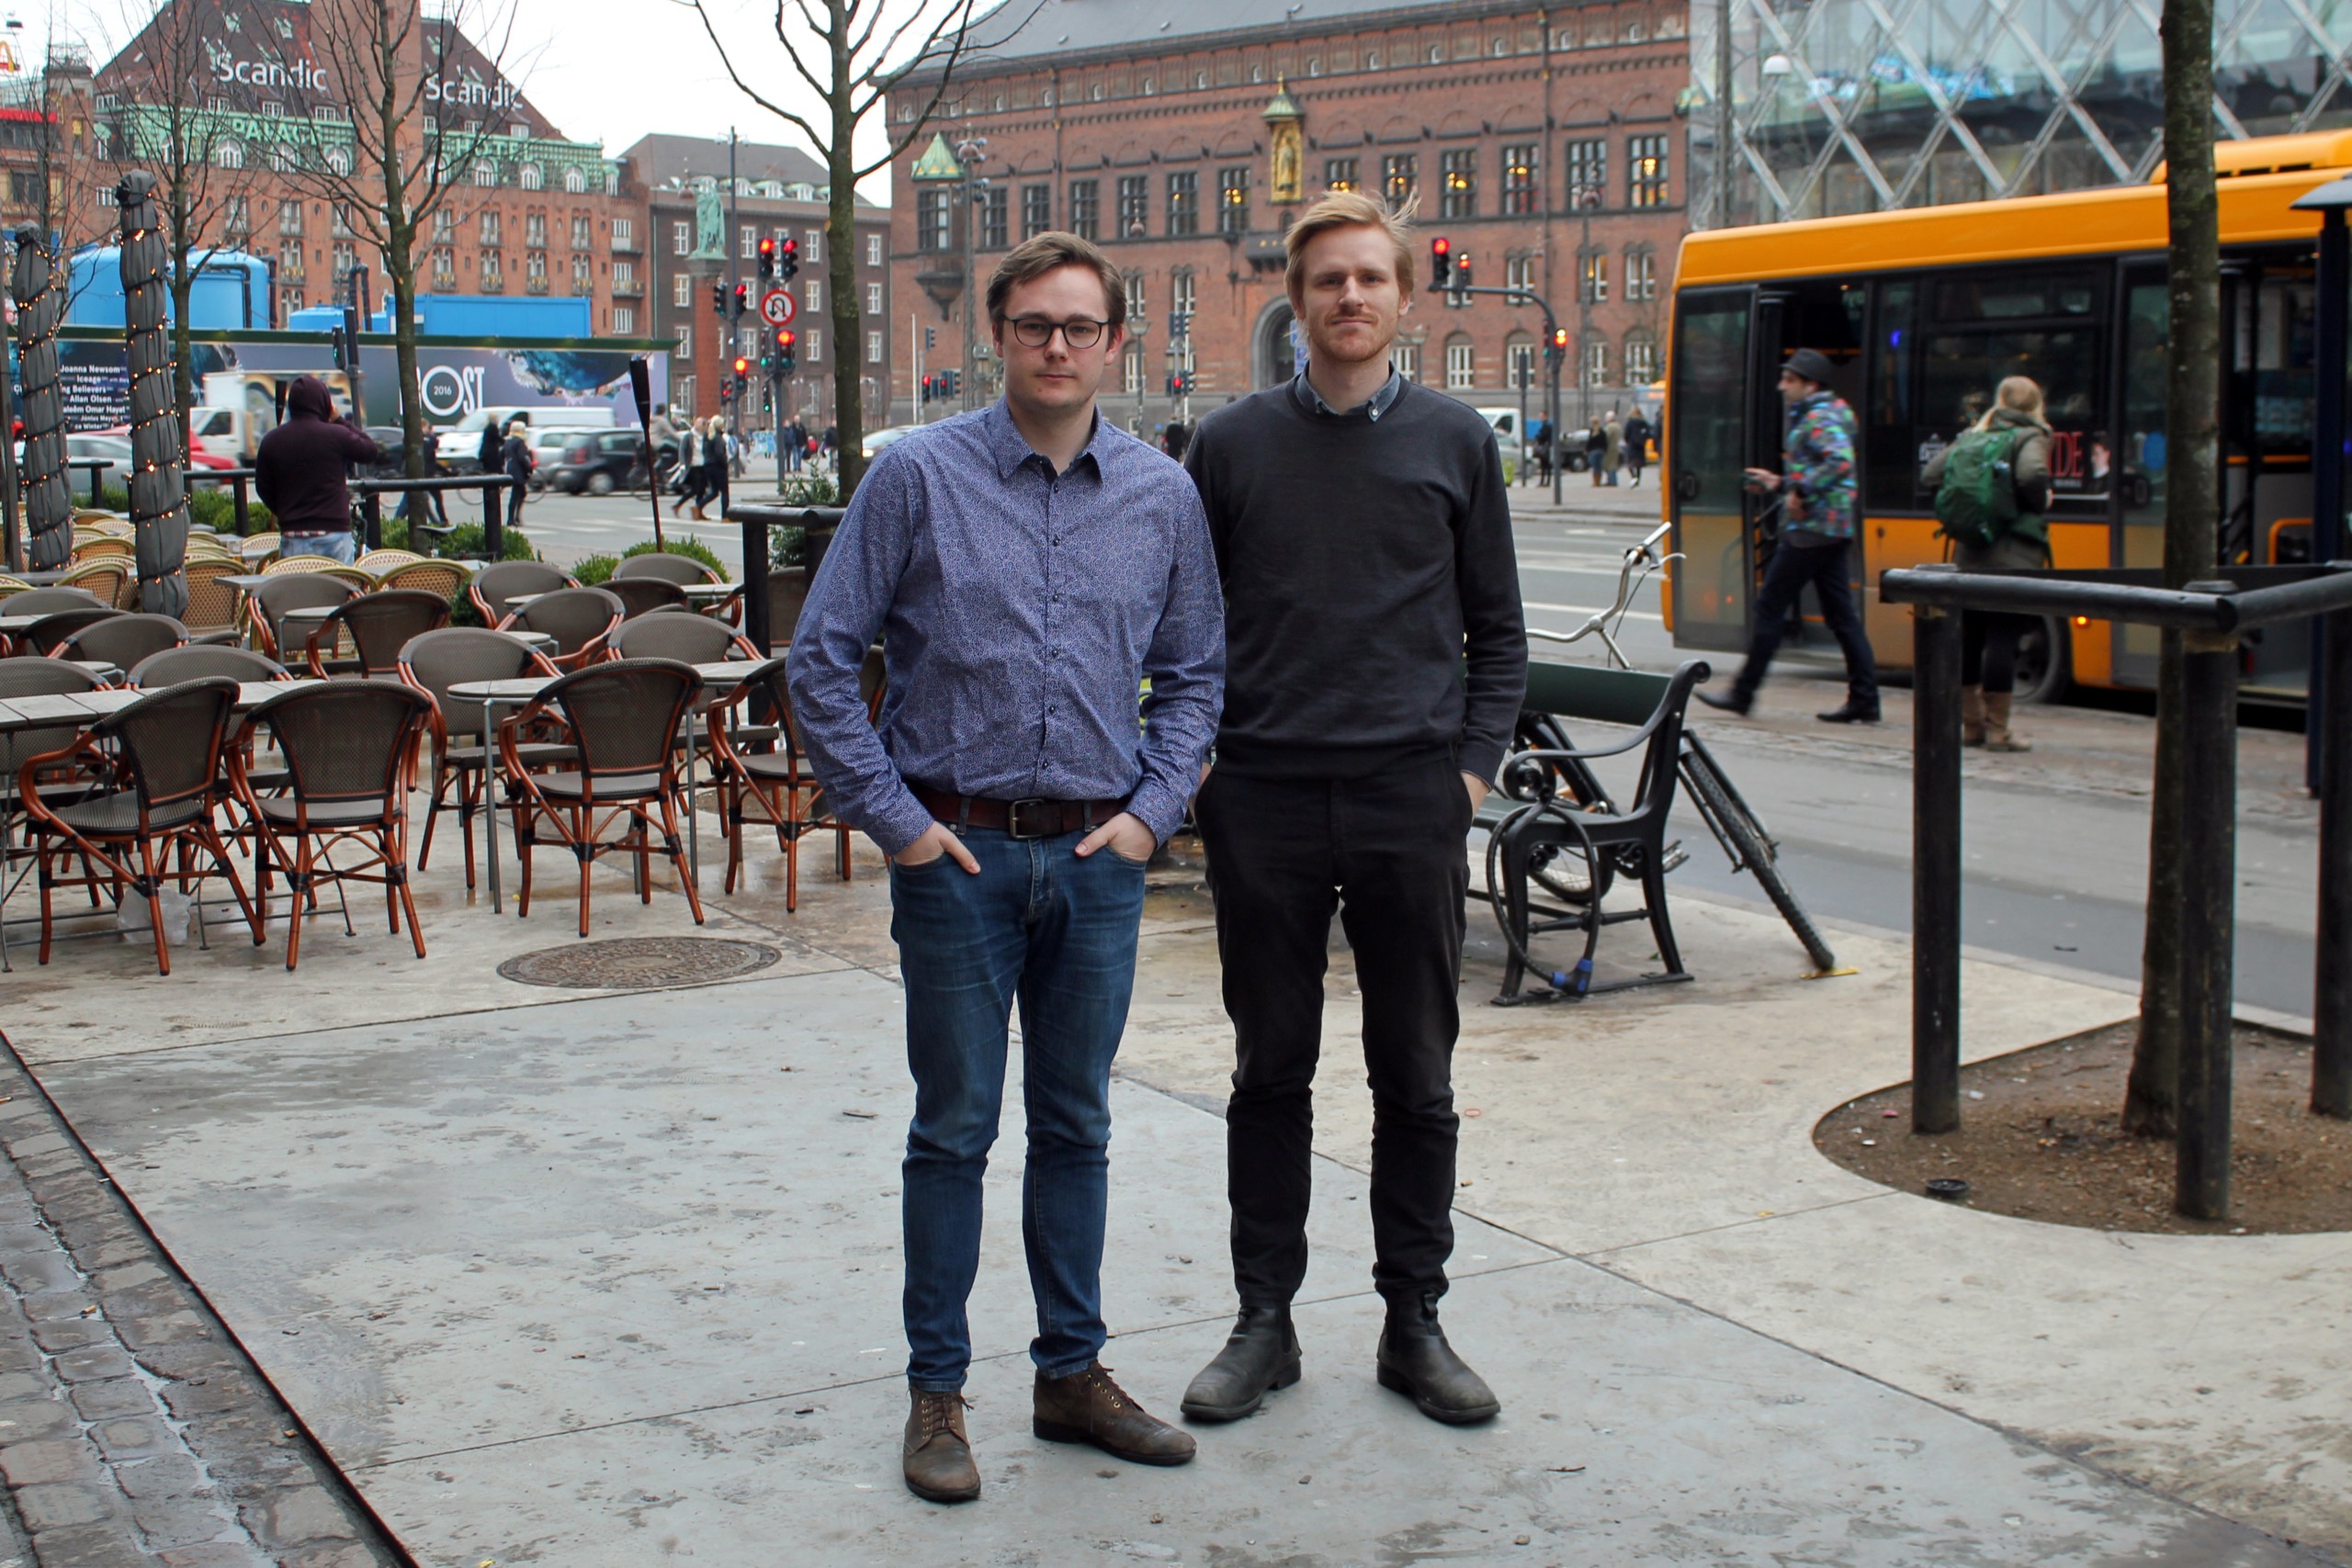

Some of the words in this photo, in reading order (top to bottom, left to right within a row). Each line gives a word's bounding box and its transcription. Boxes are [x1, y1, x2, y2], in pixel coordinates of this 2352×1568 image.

[216, 51, 327, 91] Scandic
[424, 73, 524, 108] Scandic
[60, 365, 87, 373] Joanna
[89, 365, 120, 373] Newsom
[76, 375, 101, 384] Iceage
[73, 385, 107, 394] Believers
[434, 386, 452, 395] 2016
[85, 405, 104, 413] Omar
[106, 405, 126, 414] Hayat
